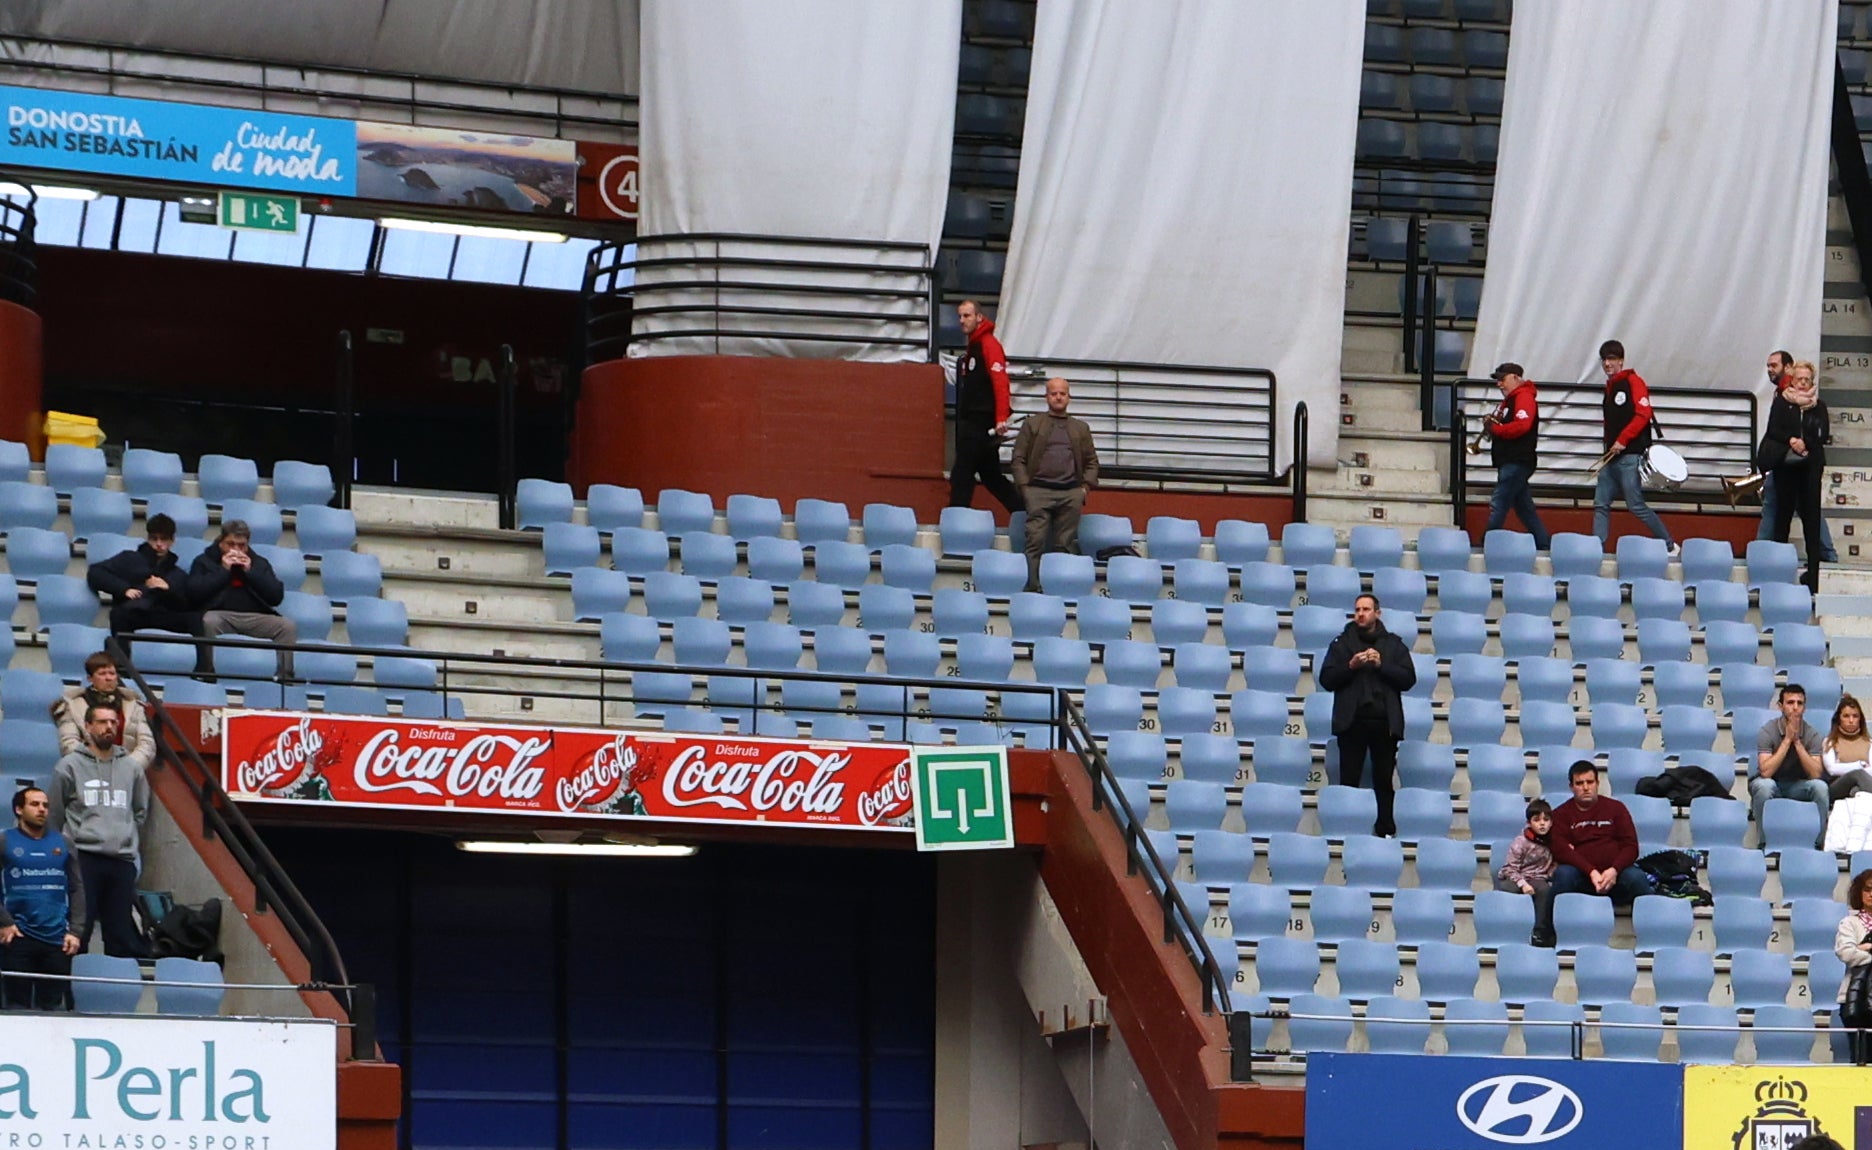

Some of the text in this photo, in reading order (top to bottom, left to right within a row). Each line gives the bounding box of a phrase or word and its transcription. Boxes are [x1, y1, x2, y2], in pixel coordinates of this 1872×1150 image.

[8, 105, 144, 138] DONOSTIA
[237, 121, 317, 152] Ciudad
[8, 127, 198, 163] SAN SEBASTIÁN
[211, 141, 344, 182] de moda
[616, 169, 639, 204] 4
[1831, 251, 1843, 261] 15
[1827, 356, 1869, 368] FILA 13
[1840, 412, 1865, 423] FILA
[921, 622, 935, 633] 30
[1573, 690, 1579, 702] 1
[1638, 692, 1646, 704] 2
[1706, 694, 1714, 705] 3
[1139, 719, 1155, 731] 30
[1213, 721, 1228, 733] 31
[1284, 723, 1301, 736] 32
[409, 727, 456, 742] Disfruta
[237, 717, 323, 793] Coca-Cola
[715, 743, 760, 757] Disfruta
[353, 728, 553, 799] Coca-Cola
[556, 734, 637, 813] Coca-Cola
[662, 745, 852, 814] Coca-Cola
[1305, 771, 1322, 783] 32
[857, 757, 911, 826] Coca-C
[1212, 917, 1228, 929] 17
[1287, 919, 1304, 931] 18
[1697, 930, 1703, 941] 1
[1770, 931, 1779, 943] 2
[1725, 984, 1731, 996] 1
[1798, 985, 1807, 997] 2
[71, 1037, 271, 1124] Perla
[63, 1133, 271, 1150] TALASO-SPORT
